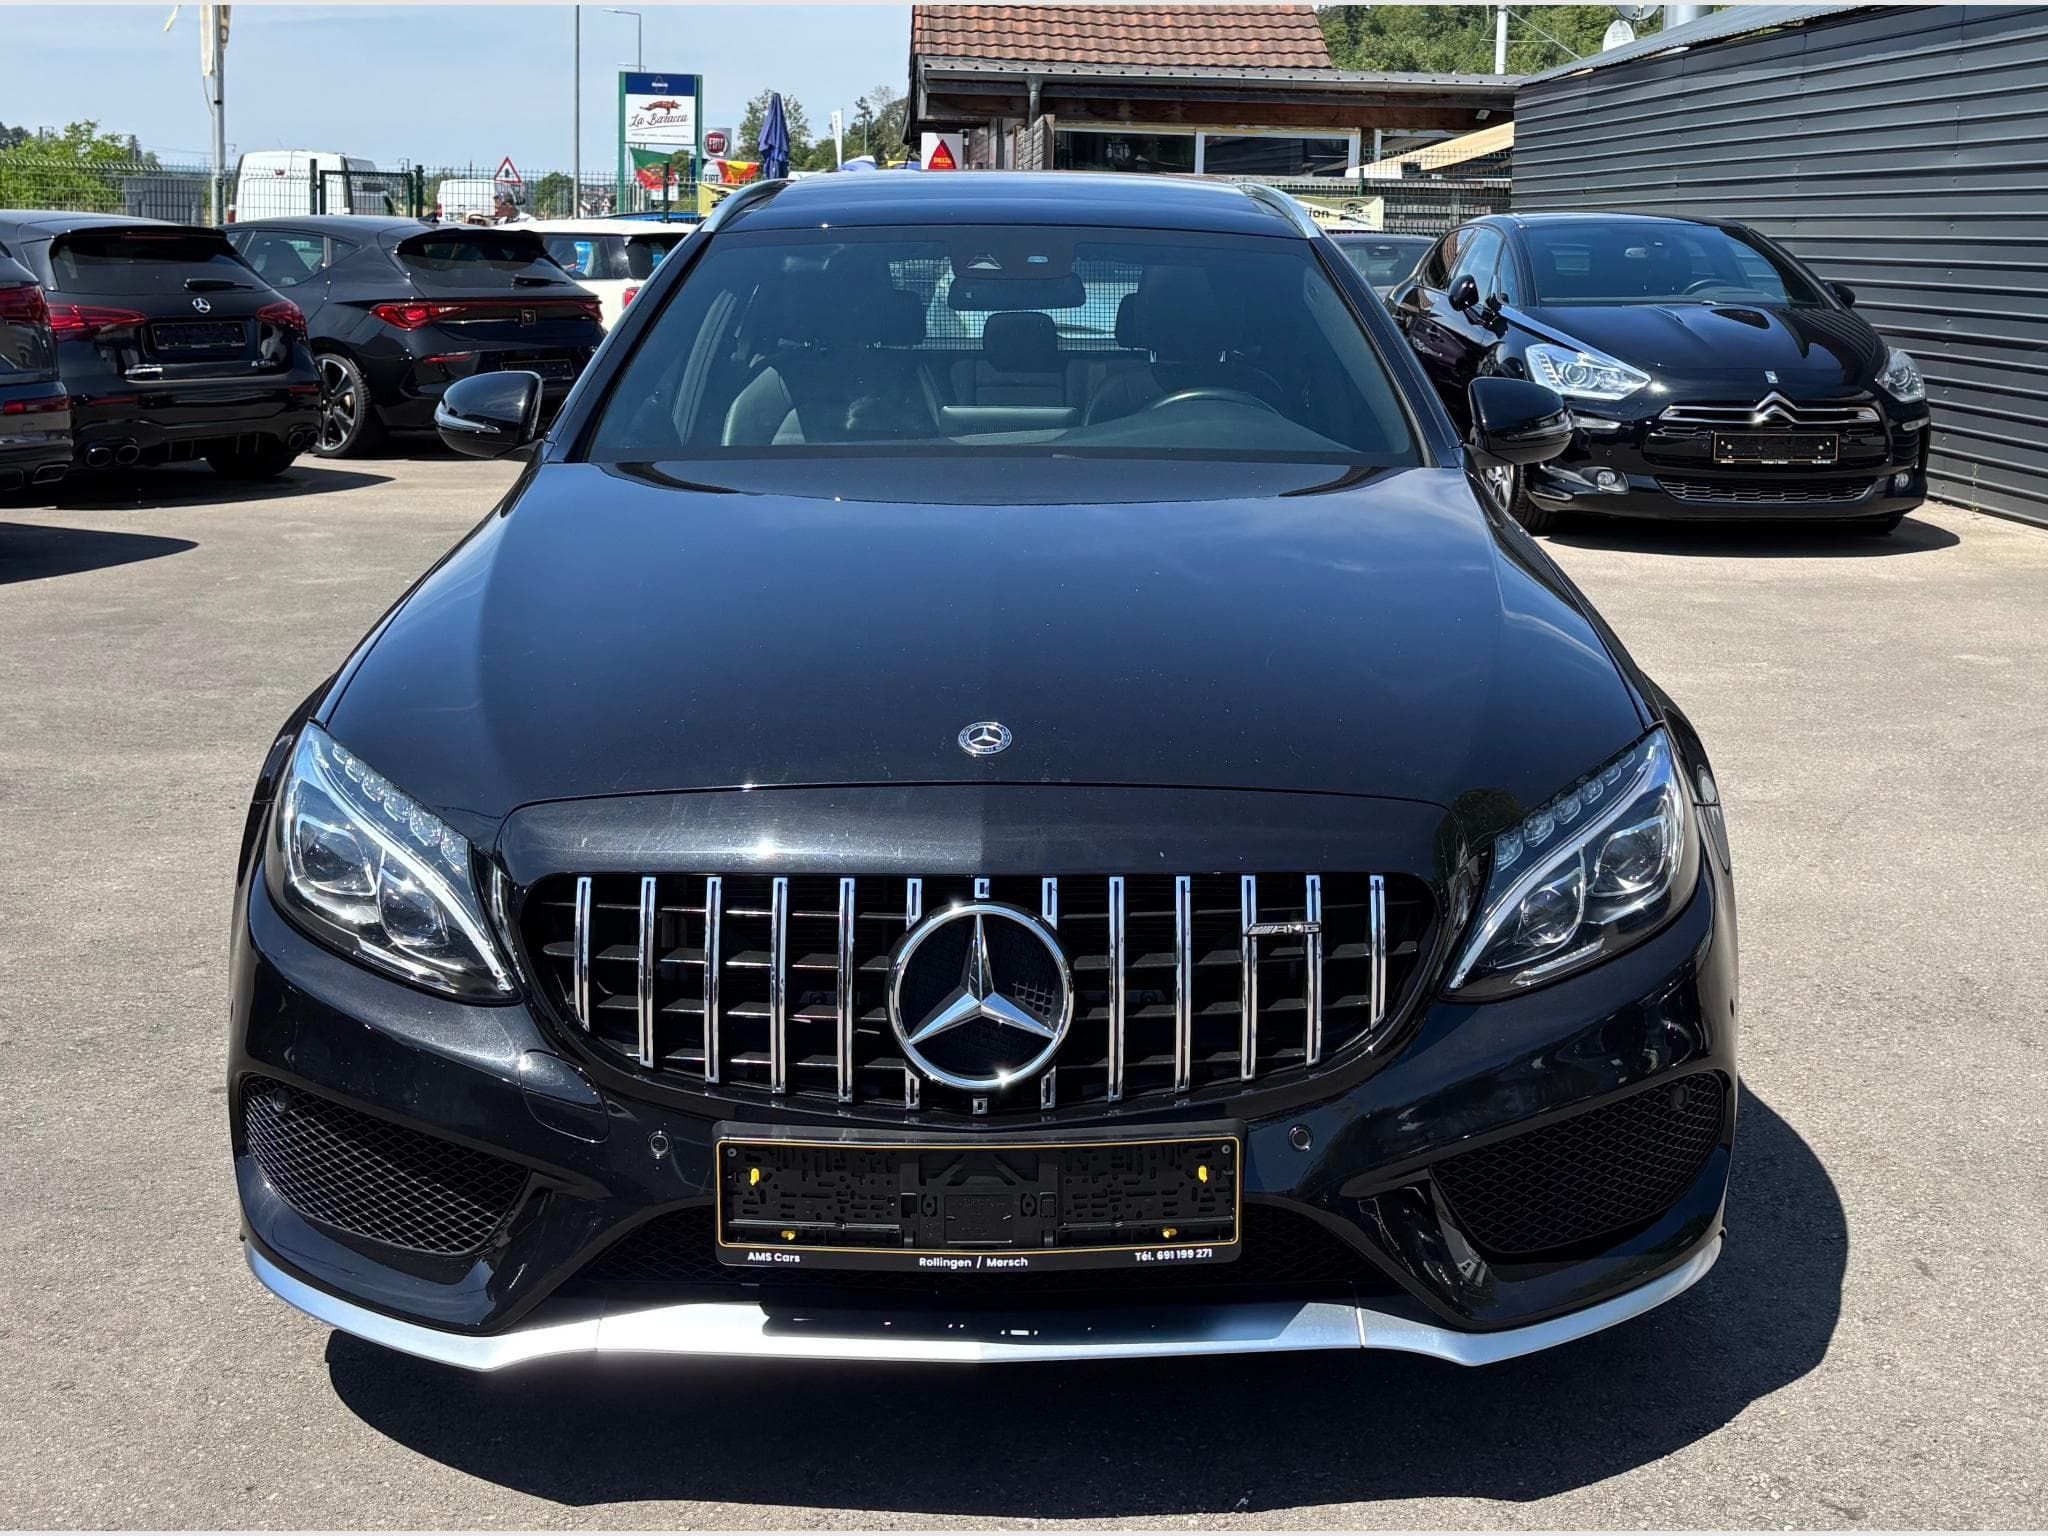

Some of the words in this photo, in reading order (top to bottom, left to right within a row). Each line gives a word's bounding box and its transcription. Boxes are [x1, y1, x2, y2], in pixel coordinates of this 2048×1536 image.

[629, 113, 644, 127] La
[647, 113, 688, 125] Baracca
[1270, 923, 1320, 934] AMG
[747, 1252, 772, 1262] AMS
[774, 1252, 800, 1263] Cars
[1135, 1251, 1154, 1261] Tél.
[1157, 1250, 1175, 1260] 691
[1176, 1249, 1194, 1259] 199
[1196, 1248, 1213, 1258] 271
[919, 1257, 972, 1270] Rollingen
